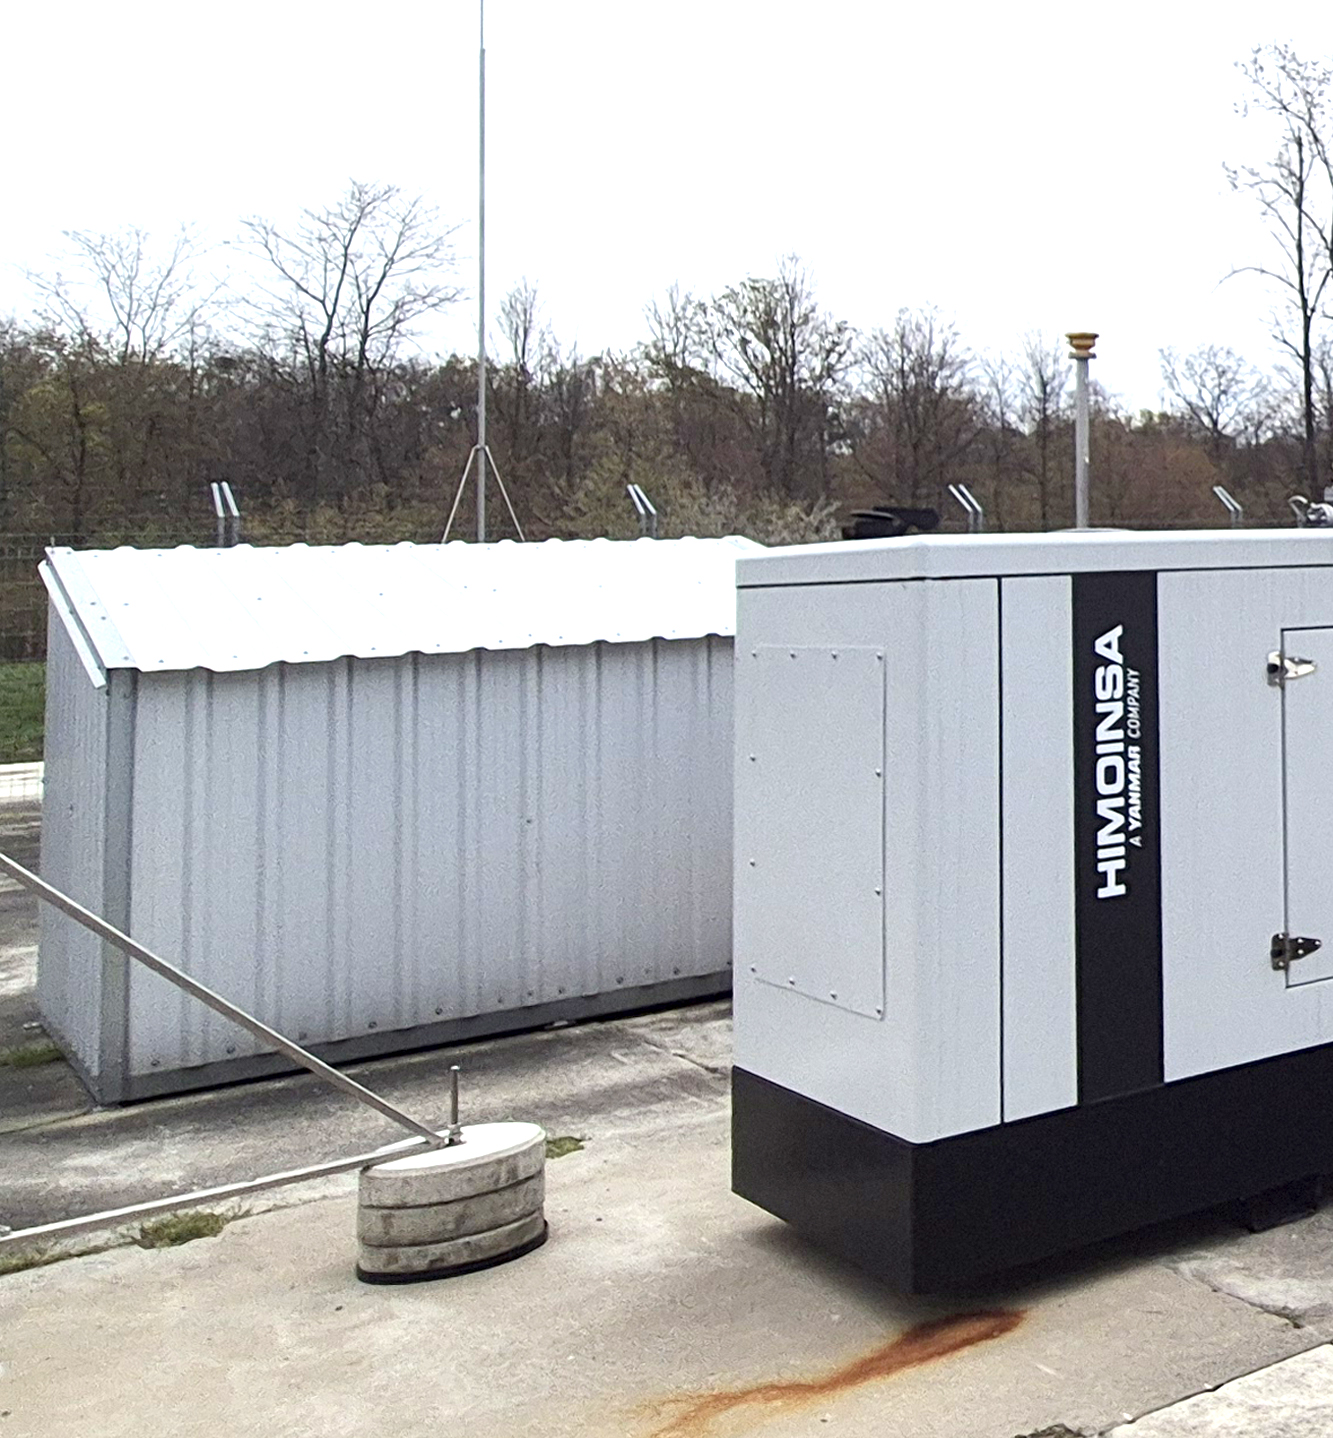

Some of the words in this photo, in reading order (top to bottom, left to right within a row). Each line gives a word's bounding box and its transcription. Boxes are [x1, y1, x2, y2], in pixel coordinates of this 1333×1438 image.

[1126, 667, 1142, 739] COMPANY
[1094, 624, 1126, 899] HIMOINSA
[1127, 745, 1142, 832] YANMAR
[1129, 835, 1142, 848] A
